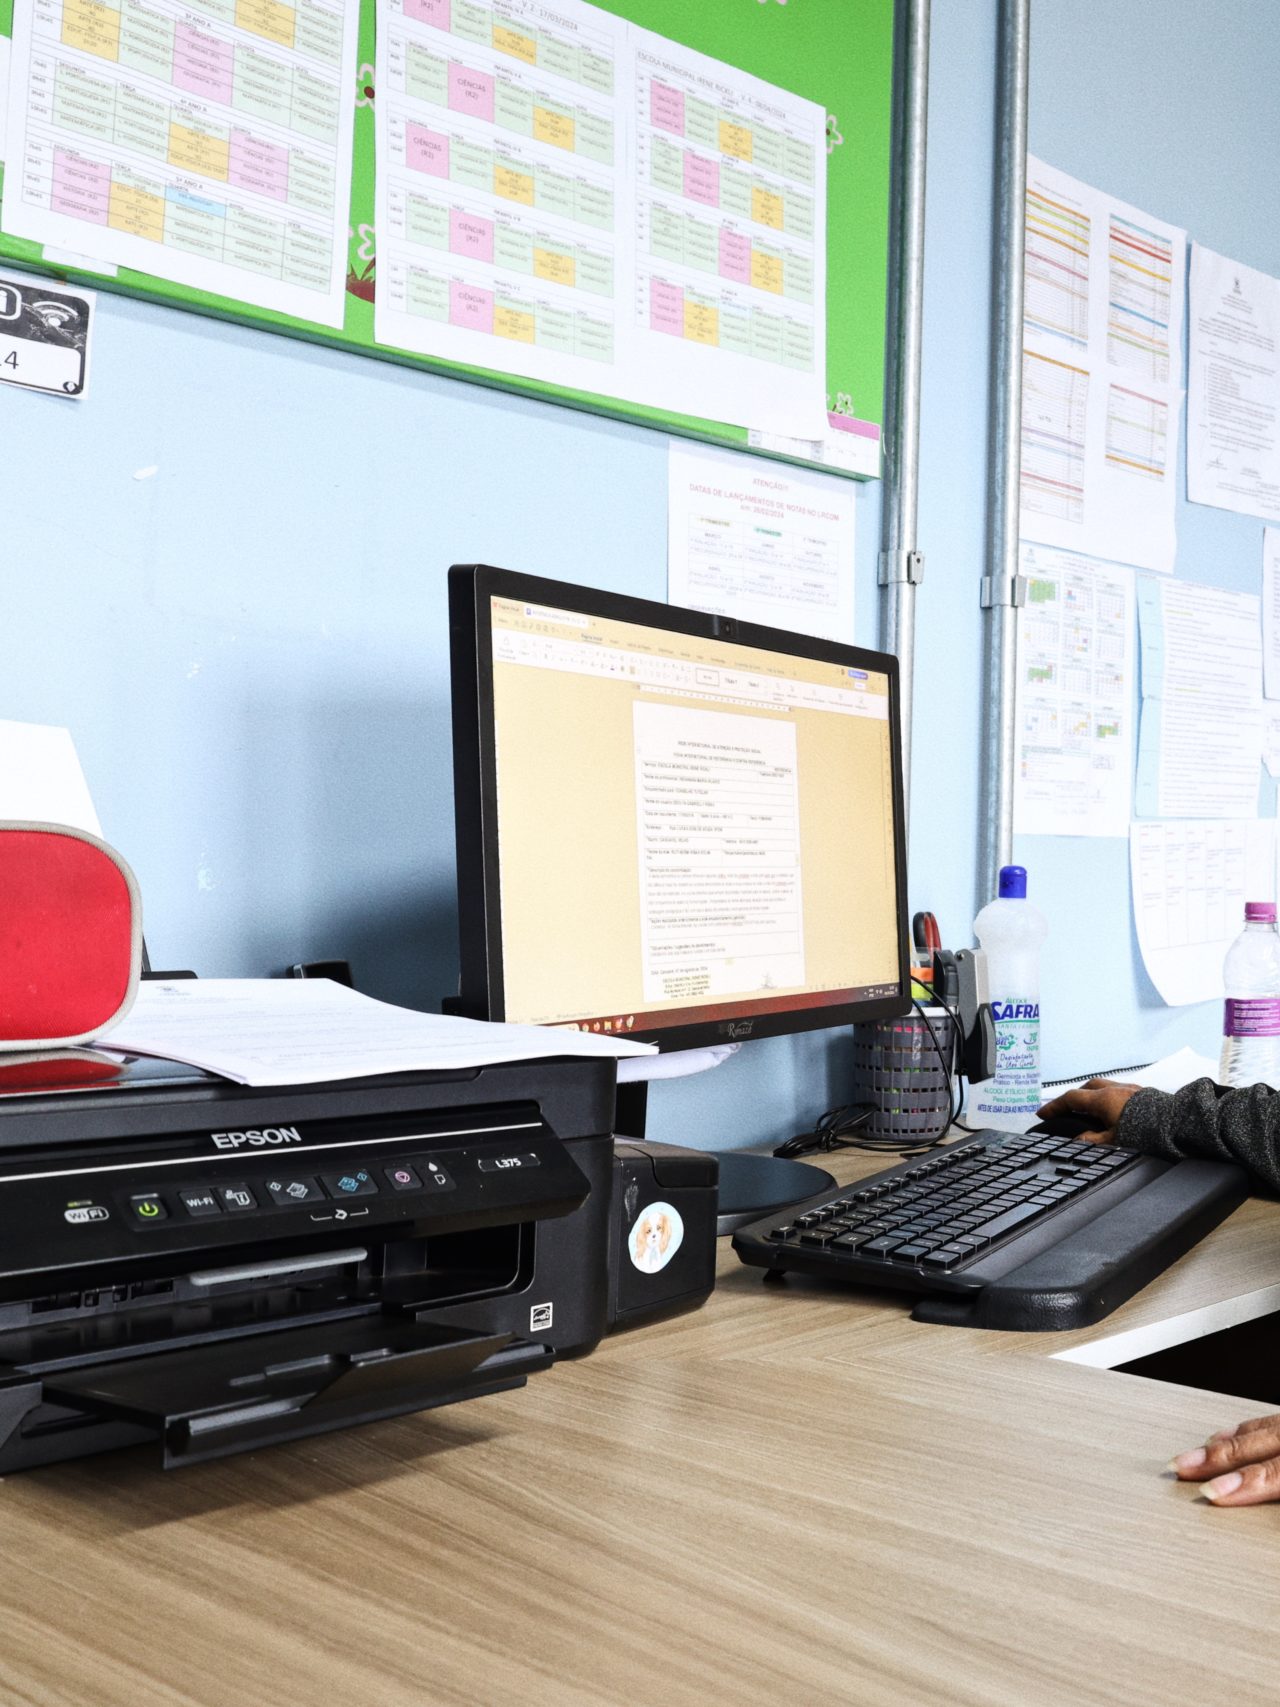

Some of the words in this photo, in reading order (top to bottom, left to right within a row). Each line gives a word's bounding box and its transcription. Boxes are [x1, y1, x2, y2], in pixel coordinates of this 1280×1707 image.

[457, 78, 486, 93] CIÊNCIAS
[413, 137, 442, 152] CIÊNCIAS
[459, 223, 486, 237] CIÊNCIAS
[459, 292, 486, 305] CIÊNCIAS
[0, 351, 19, 370] 4
[991, 1001, 1040, 1021] SAFRA
[211, 1127, 302, 1149] EPSON
[495, 1158, 522, 1168] L375
